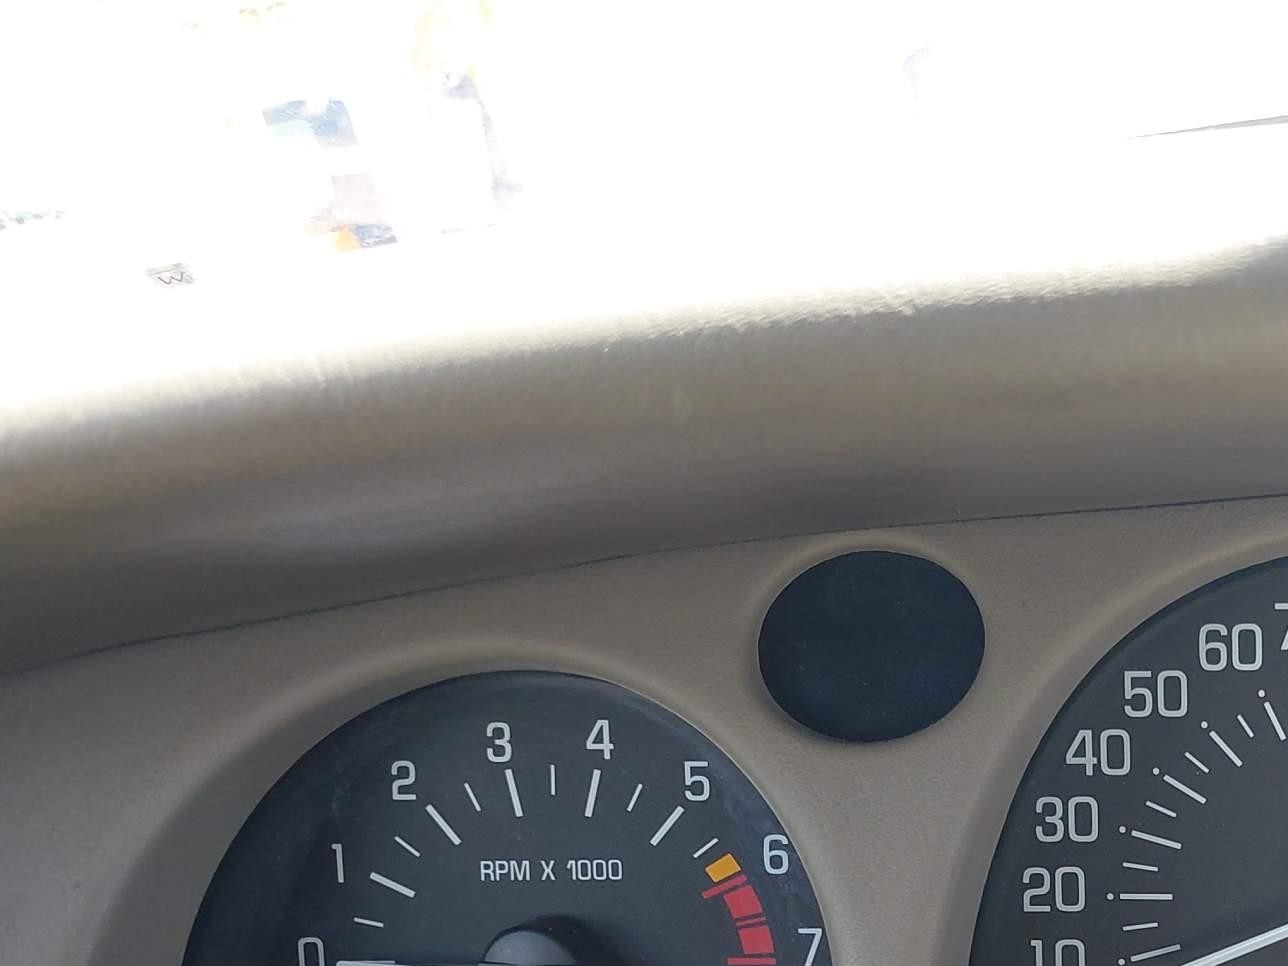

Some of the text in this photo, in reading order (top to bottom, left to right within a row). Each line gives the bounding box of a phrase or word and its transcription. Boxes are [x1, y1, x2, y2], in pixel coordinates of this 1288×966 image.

[1199, 624, 1262, 670] 60
[1125, 671, 1187, 717] 50
[487, 722, 511, 762] 3
[587, 720, 614, 759] 4
[1066, 729, 1130, 775] 40
[392, 761, 416, 800] 2
[685, 761, 709, 800] 5
[1036, 797, 1098, 842] 30
[332, 844, 344, 883] 1
[481, 860, 622, 880] RPM X 1000
[764, 835, 789, 874] 6
[1023, 867, 1085, 911] 20
[798, 928, 822, 966] 7
